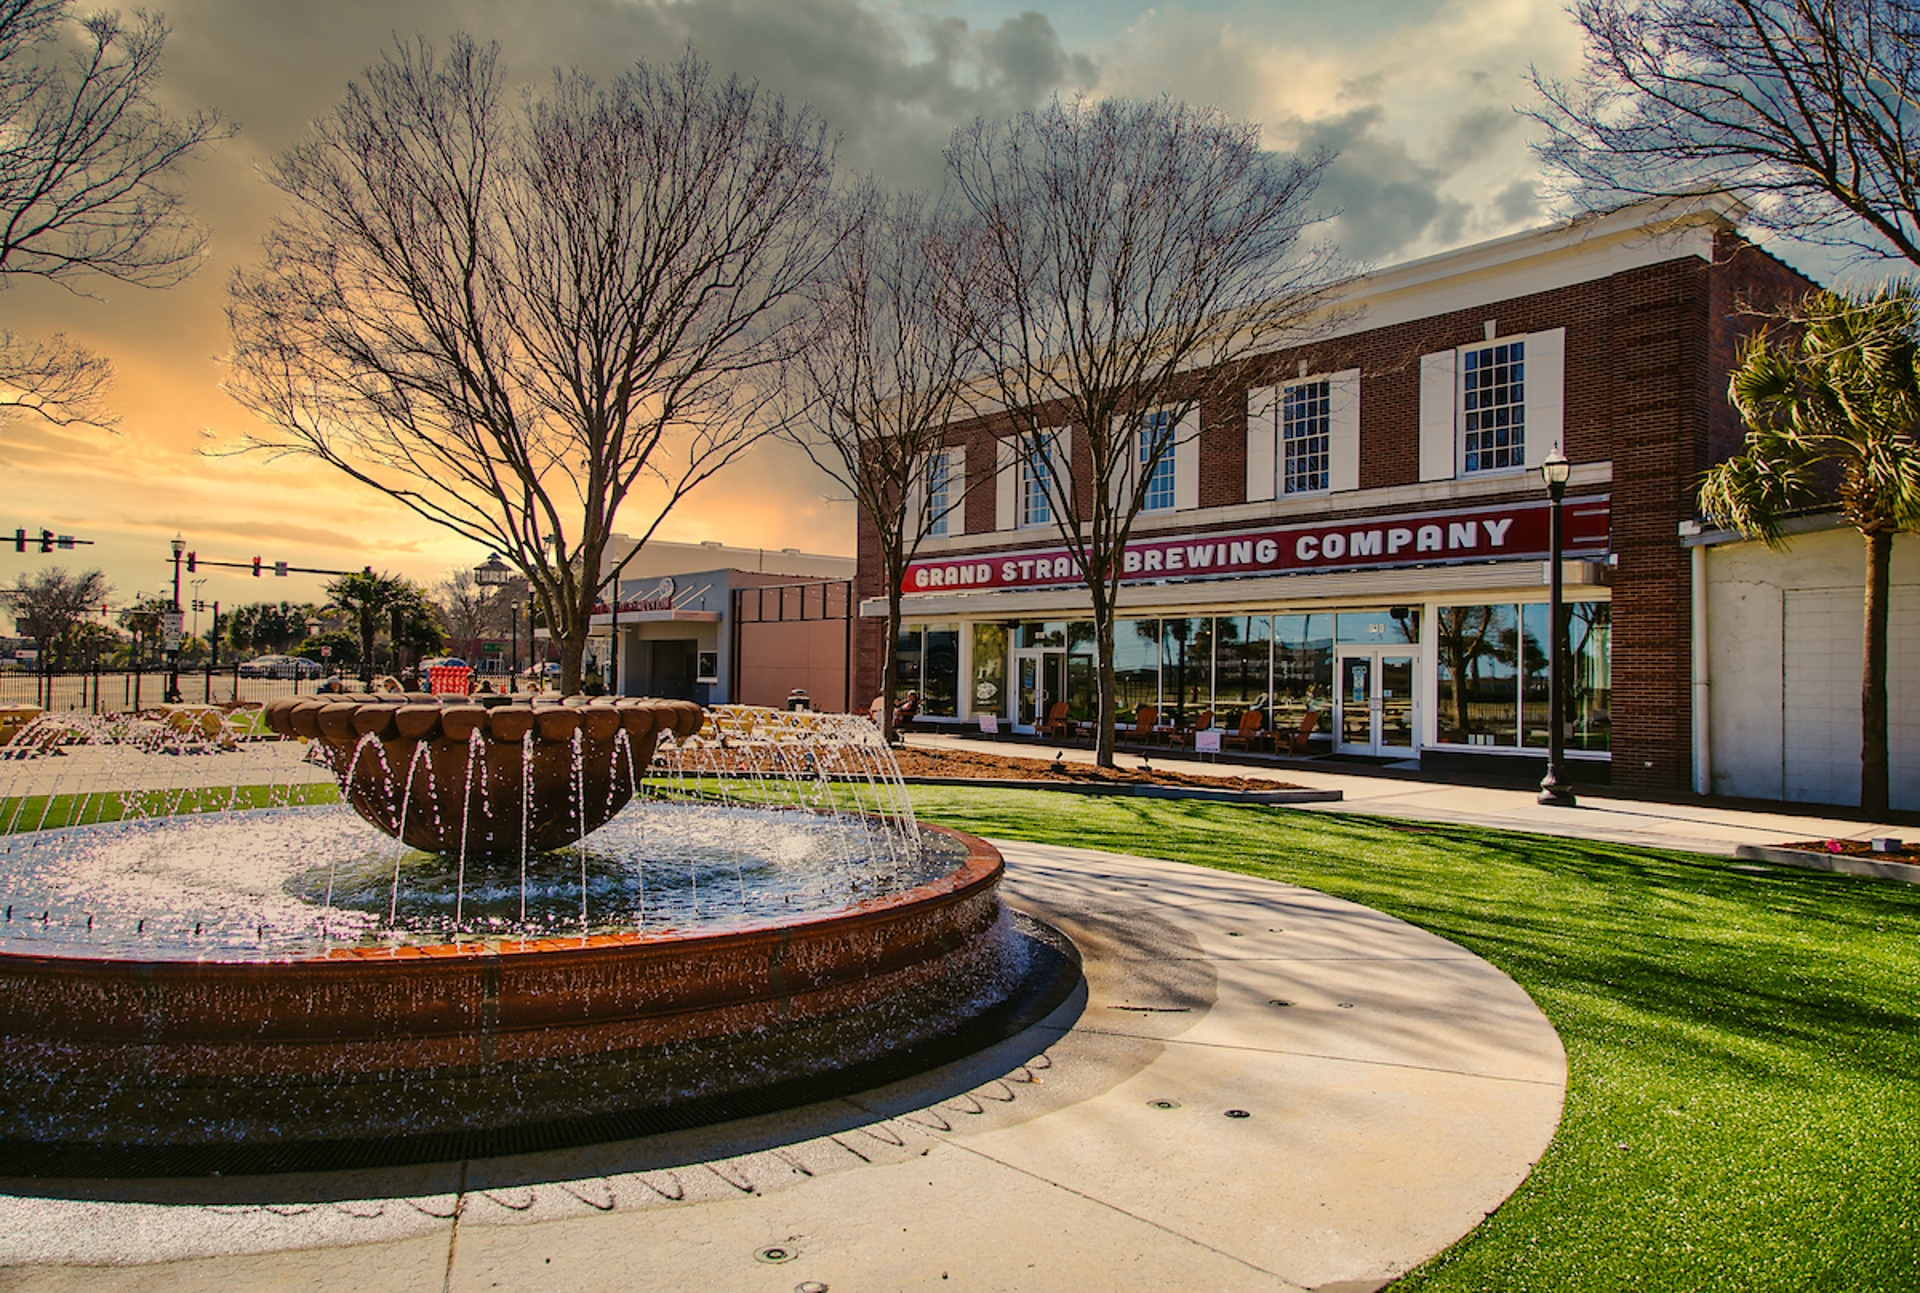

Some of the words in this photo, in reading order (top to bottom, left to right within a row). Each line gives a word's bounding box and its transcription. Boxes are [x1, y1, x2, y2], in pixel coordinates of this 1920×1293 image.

[915, 564, 993, 588] GRAND
[1002, 555, 1092, 582] STRAN
[1123, 538, 1279, 573] BREWING
[1296, 518, 1514, 561] COMPANY
